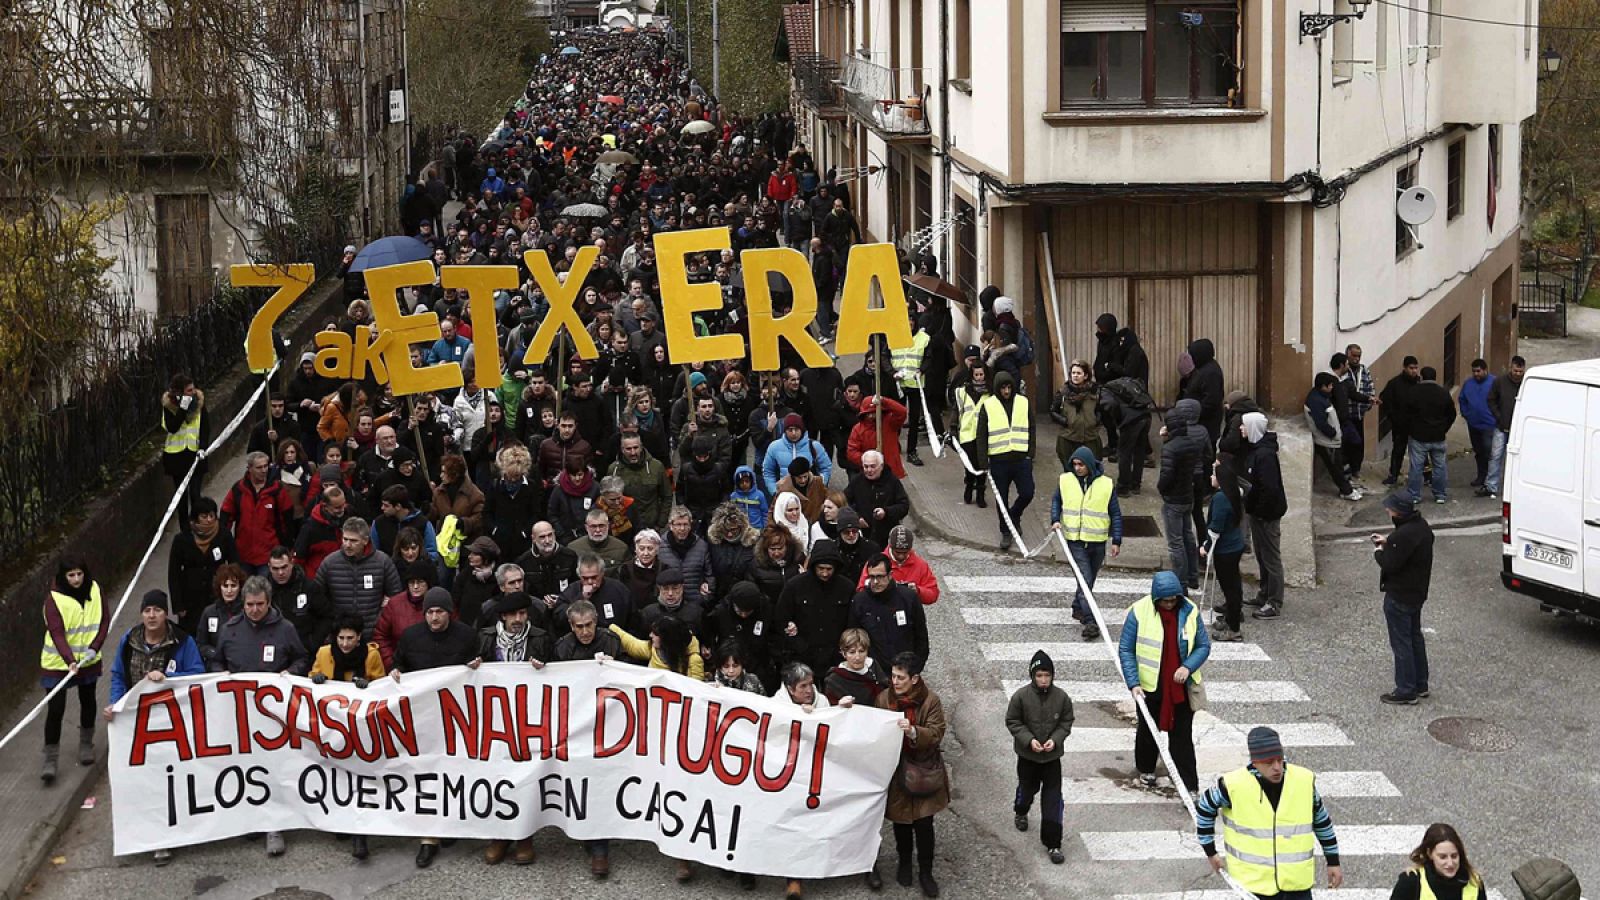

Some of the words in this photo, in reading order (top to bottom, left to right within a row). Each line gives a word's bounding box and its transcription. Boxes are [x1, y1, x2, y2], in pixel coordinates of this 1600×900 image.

[129, 679, 419, 766] ALTSASUN
[437, 684, 569, 762] NAHI
[593, 686, 830, 810] DITUGU!
[299, 764, 520, 820] QUEREMOS
[539, 773, 588, 820] EN
[616, 776, 741, 860] CASA!
